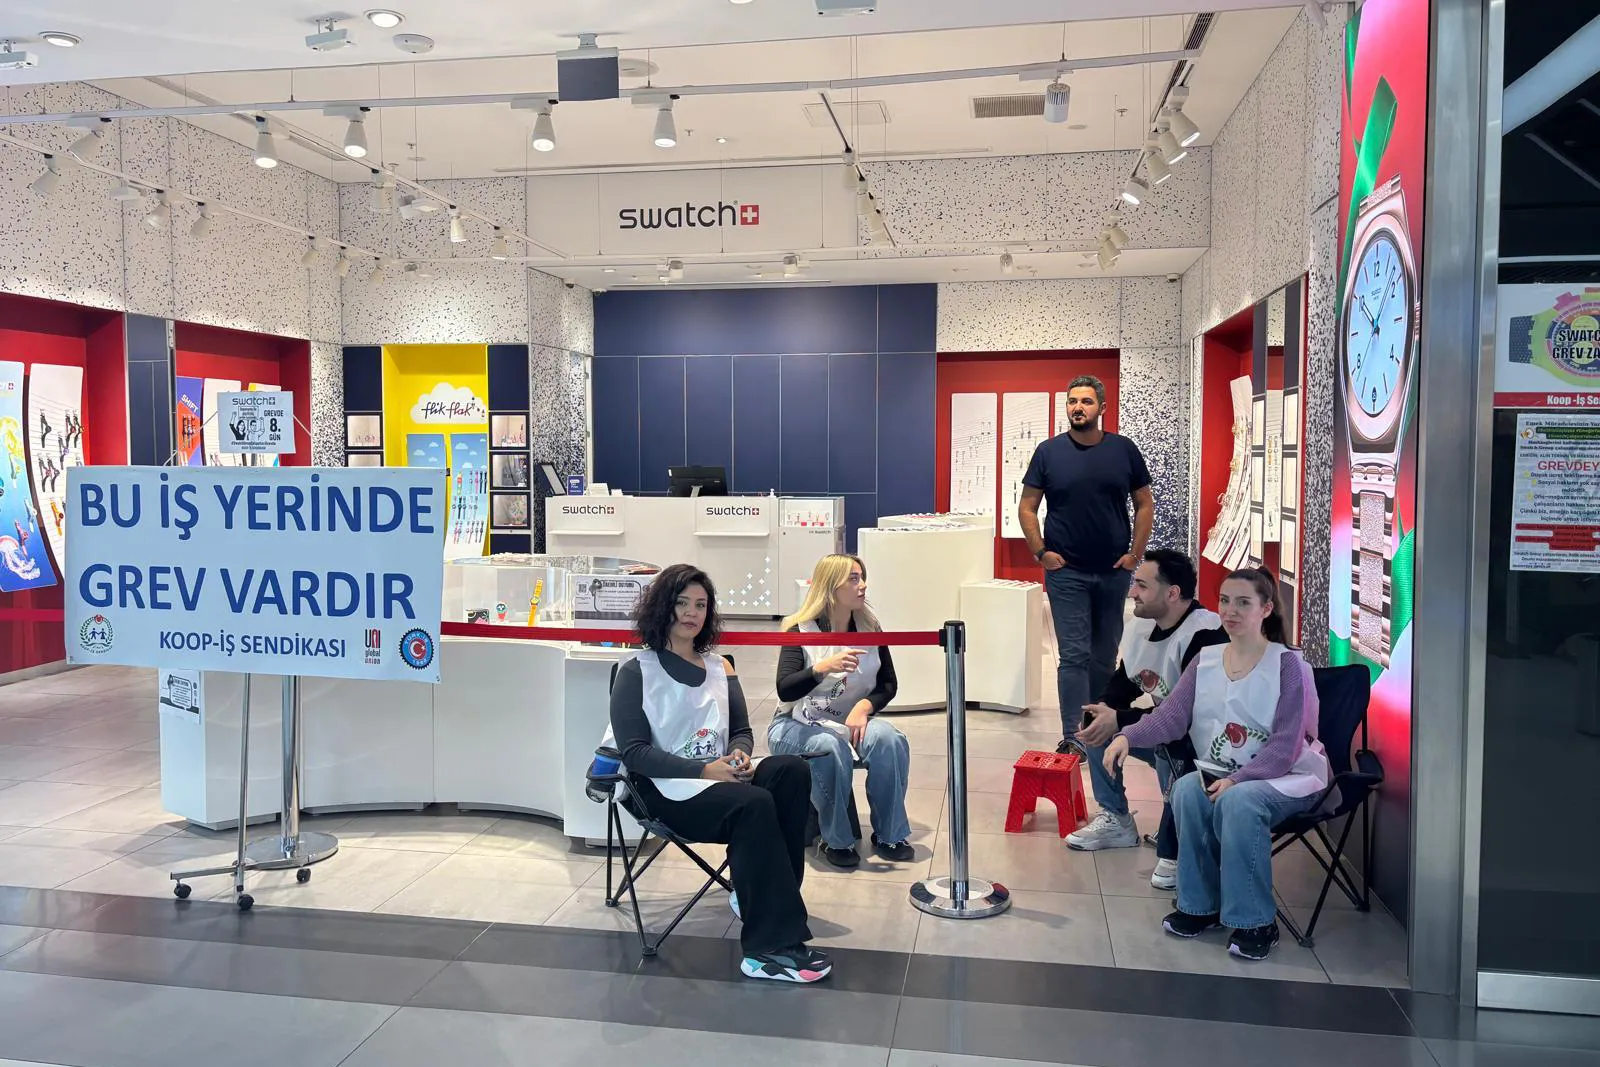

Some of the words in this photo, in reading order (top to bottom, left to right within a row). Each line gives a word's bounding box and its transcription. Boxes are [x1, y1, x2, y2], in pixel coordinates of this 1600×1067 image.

[619, 201, 737, 229] swatch
[1552, 347, 1584, 359] GREV
[181, 393, 199, 412] SHIFT
[232, 397, 269, 405] swatch
[421, 401, 446, 420] flik
[446, 401, 473, 419] flak
[269, 433, 281, 441] GÜN
[1537, 461, 1600, 472] GREVDEY
[80, 483, 141, 529] BU
[160, 473, 200, 541] İŞ
[213, 474, 435, 534] YERİNDE
[562, 504, 607, 515] swatch
[706, 505, 752, 516] swatch
[78, 563, 207, 612] GREV
[219, 567, 416, 620] VARDIR
[159, 629, 236, 657] KOOP-İŞ
[240, 634, 346, 658] SENDİKASI
[365, 649, 381, 657] global
